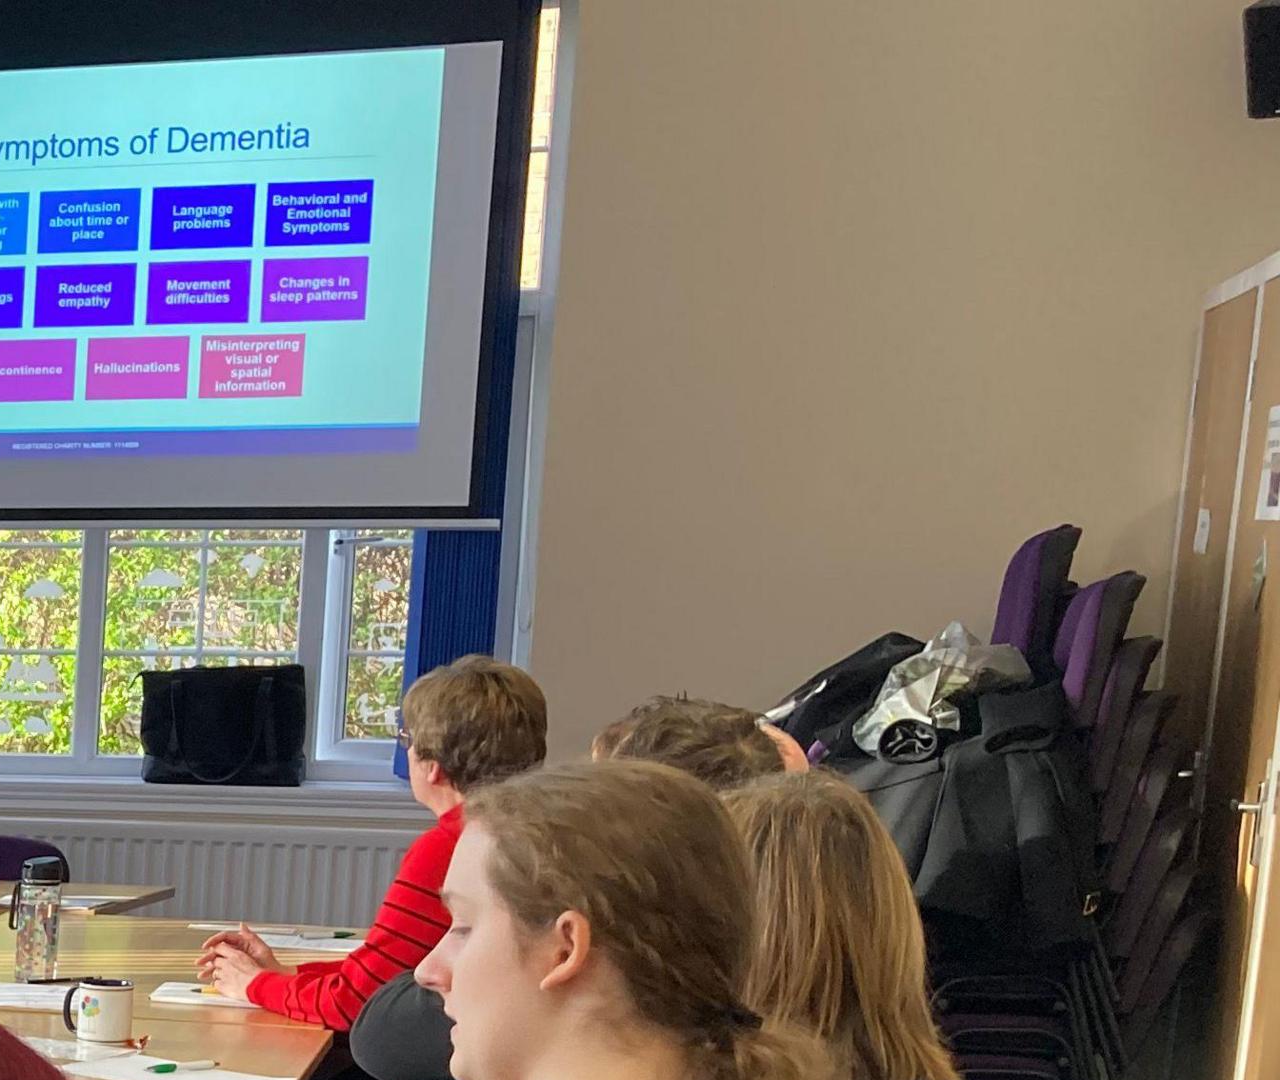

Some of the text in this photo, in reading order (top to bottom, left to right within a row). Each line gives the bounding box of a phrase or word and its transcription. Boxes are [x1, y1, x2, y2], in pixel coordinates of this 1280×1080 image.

[129, 127, 159, 155] of
[167, 122, 310, 154] Dementia
[272, 191, 368, 206] Behavioral and
[58, 201, 122, 214] Confusion
[172, 203, 234, 217] Language
[287, 206, 351, 219] Emotional
[49, 214, 129, 228] about time or
[172, 217, 231, 232] problems
[282, 221, 350, 235] Symptoms
[71, 229, 105, 242] place
[58, 282, 112, 294] Reduced
[166, 278, 231, 291] Movement
[279, 275, 350, 289] Changes in
[58, 295, 111, 309] empathy
[165, 291, 230, 305] difficulties
[269, 288, 359, 303] sleep patterns
[206, 338, 300, 353] Misinterpreting
[225, 352, 279, 365] visual or
[93, 361, 181, 374] Hallucinations
[230, 366, 272, 380] spatial
[214, 379, 286, 392] information
